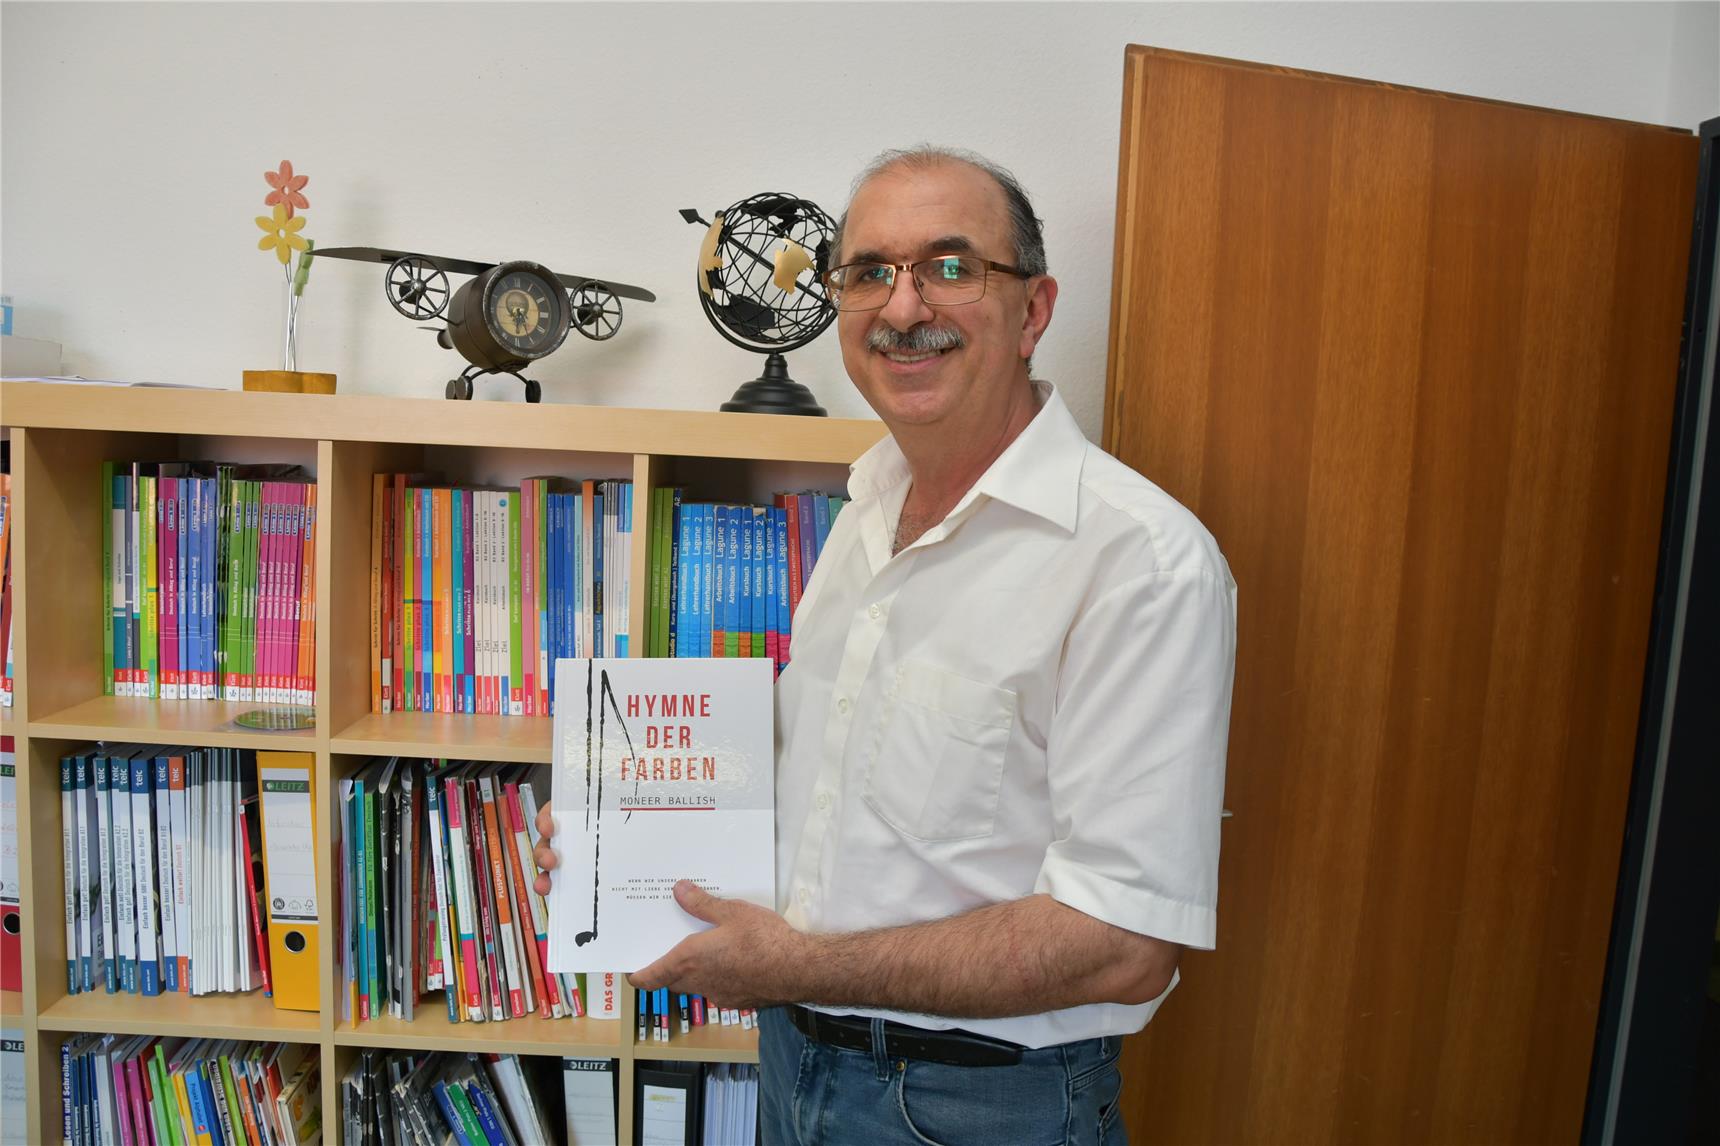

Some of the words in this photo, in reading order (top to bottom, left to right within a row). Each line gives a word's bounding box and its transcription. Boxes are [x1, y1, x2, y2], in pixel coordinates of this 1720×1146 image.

[673, 496, 681, 507] A2
[680, 525, 691, 557] Lagune
[692, 526, 702, 556] Lagune
[704, 525, 714, 555] Lagune
[715, 526, 725, 558] Lagune
[728, 528, 738, 560] Lagune
[742, 528, 752, 560] Lagune
[753, 529, 764, 561] Lagune
[765, 527, 776, 559] Lagune
[778, 530, 788, 562] Lagune
[679, 562, 688, 614] Lehrerhandbuch
[692, 563, 700, 615] Lehrerhandbuch
[704, 562, 712, 615] Lehrerhandbuch
[716, 564, 724, 602] Arbeitsbuch
[728, 565, 736, 604] Arbeitsbuch
[742, 566, 750, 597] Kursbuch
[754, 566, 762, 597] Kursbuch
[766, 564, 775, 595] Kursbuch
[780, 568, 788, 606] Arbeitsbuch
[627, 694, 711, 718] HYMNE
[646, 725, 692, 749] DER
[62, 767, 70, 784] telc
[77, 765, 85, 782] telc
[97, 767, 105, 784] telc
[112, 765, 120, 782] telc
[119, 768, 128, 785] telc
[135, 769, 144, 787] telc
[158, 765, 166, 783] telc
[171, 767, 180, 784] telc
[621, 757, 716, 781] FARBEN
[274, 781, 305, 792] LEITZ
[428, 786, 436, 802] telc
[620, 797, 661, 805] MONEER
[668, 796, 716, 805] BALLISH
[493, 860, 506, 899] PLUSPUNKT
[604, 990, 613, 1011] DAS
[62, 1053, 71, 1096] Schreiben
[577, 1061, 607, 1071] LEITZ
[63, 1098, 71, 1114] und
